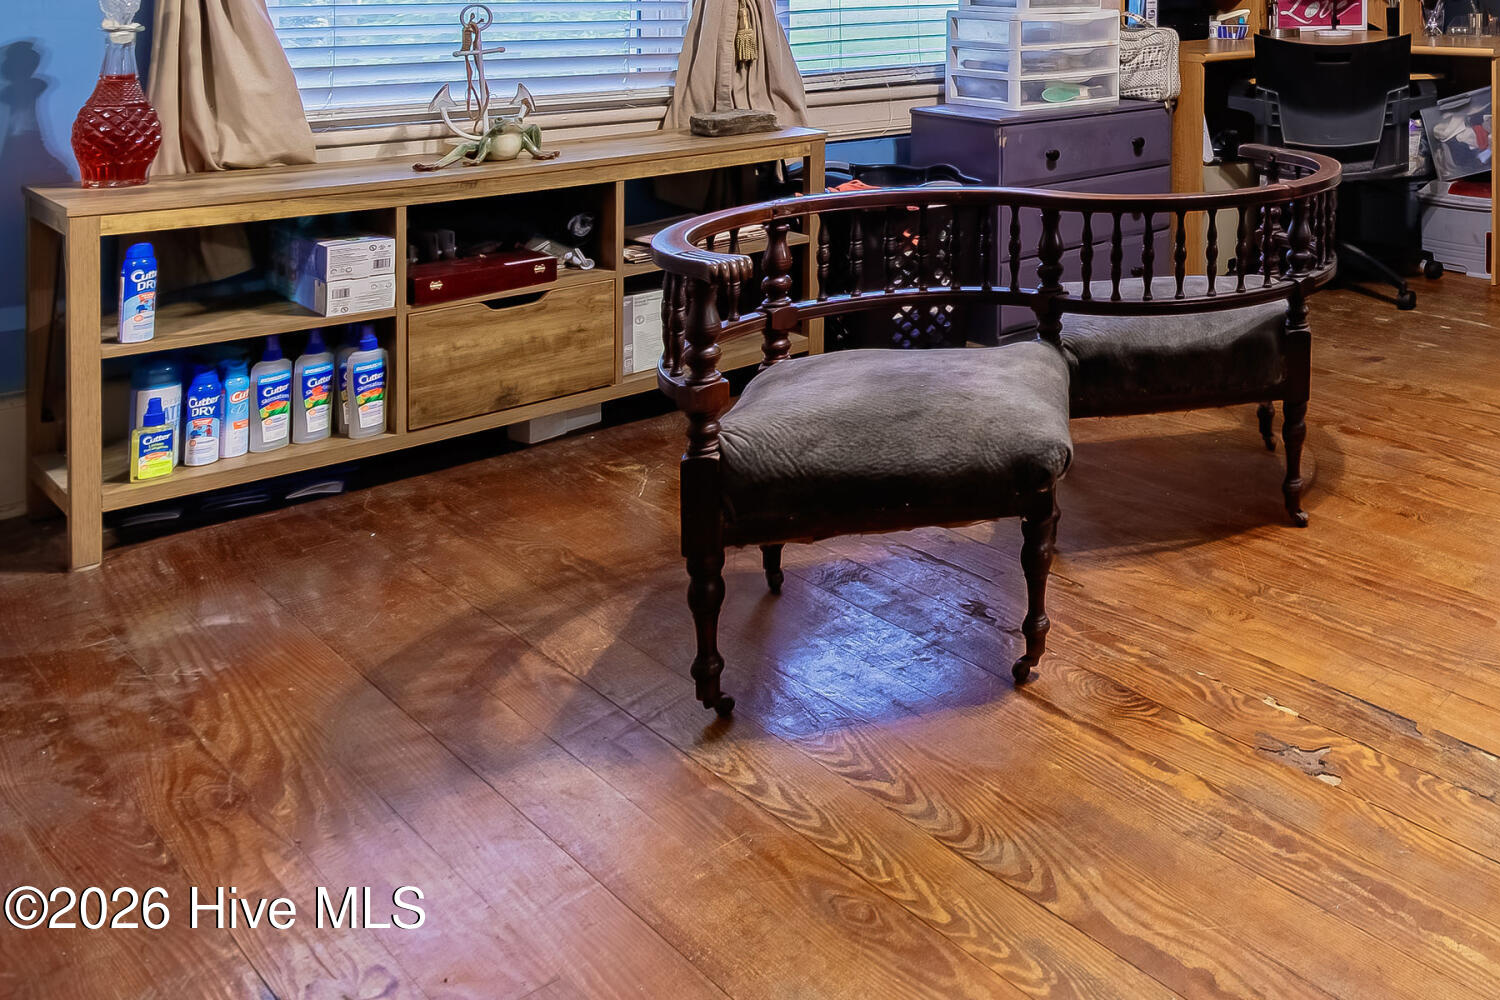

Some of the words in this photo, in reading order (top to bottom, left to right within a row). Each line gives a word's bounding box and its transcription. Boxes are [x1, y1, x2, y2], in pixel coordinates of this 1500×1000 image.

[307, 374, 332, 388] Cutter
[358, 371, 384, 384] Cutter
[263, 382, 289, 397] Cutter
[188, 395, 220, 409] Cutter
[191, 406, 216, 417] DRY
[142, 433, 172, 446] Cutter
